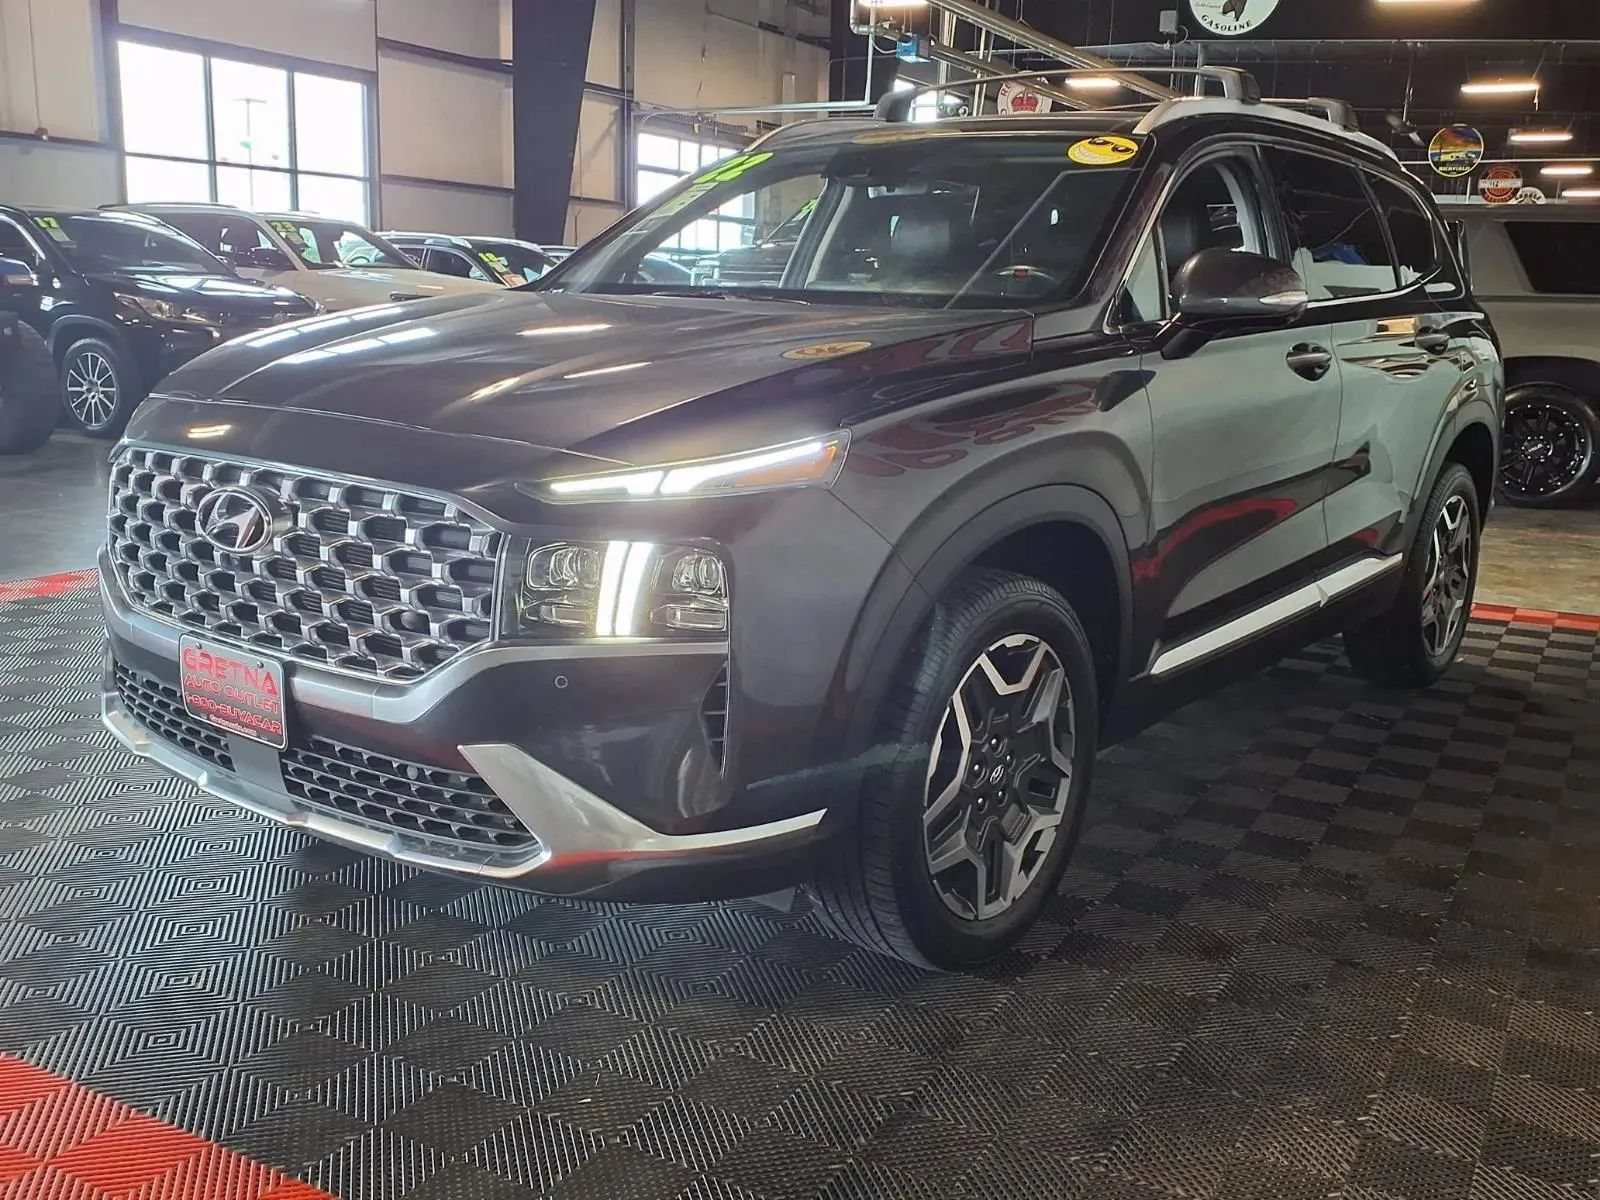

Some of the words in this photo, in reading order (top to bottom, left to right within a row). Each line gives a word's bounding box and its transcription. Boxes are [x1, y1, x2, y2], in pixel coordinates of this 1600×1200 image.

[1201, 14, 1253, 32] GASOLINE
[183, 647, 279, 697] GRETNA
[184, 673, 221, 696] AUTO
[223, 685, 281, 714] OUTLET
